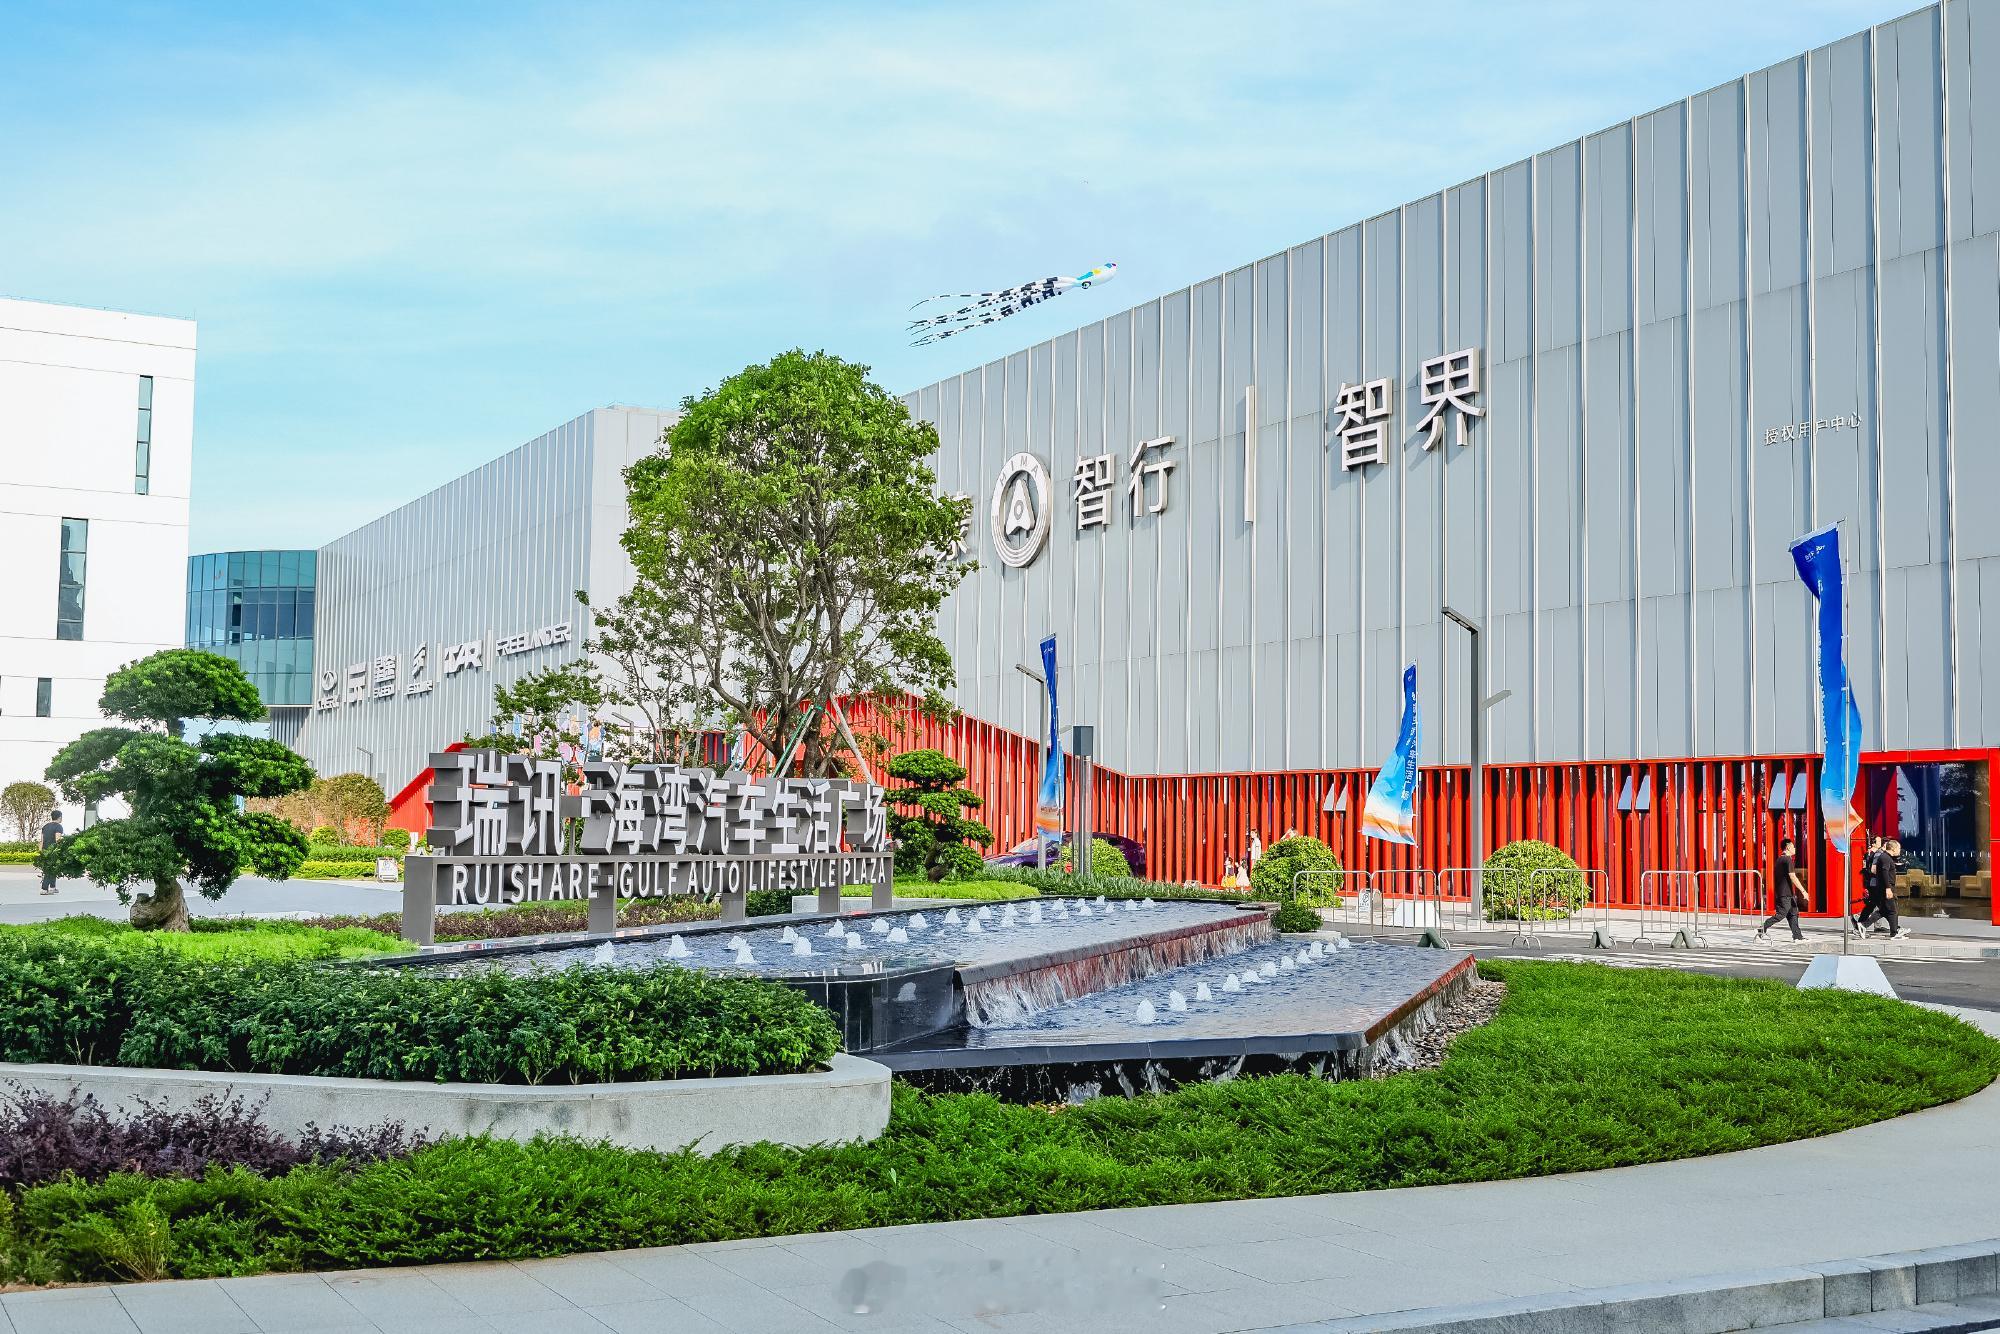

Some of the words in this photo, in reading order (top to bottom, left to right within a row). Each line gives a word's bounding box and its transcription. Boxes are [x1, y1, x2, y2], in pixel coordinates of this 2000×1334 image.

[1332, 346, 1486, 472] 智界
[1764, 412, 1862, 446] 授权用户中心
[1073, 435, 1177, 531] 智行
[619, 861, 678, 898] GULF
[687, 861, 741, 894] AUTO
[749, 859, 836, 891] LIFESTYLE
[844, 857, 886, 885] PLAZA
